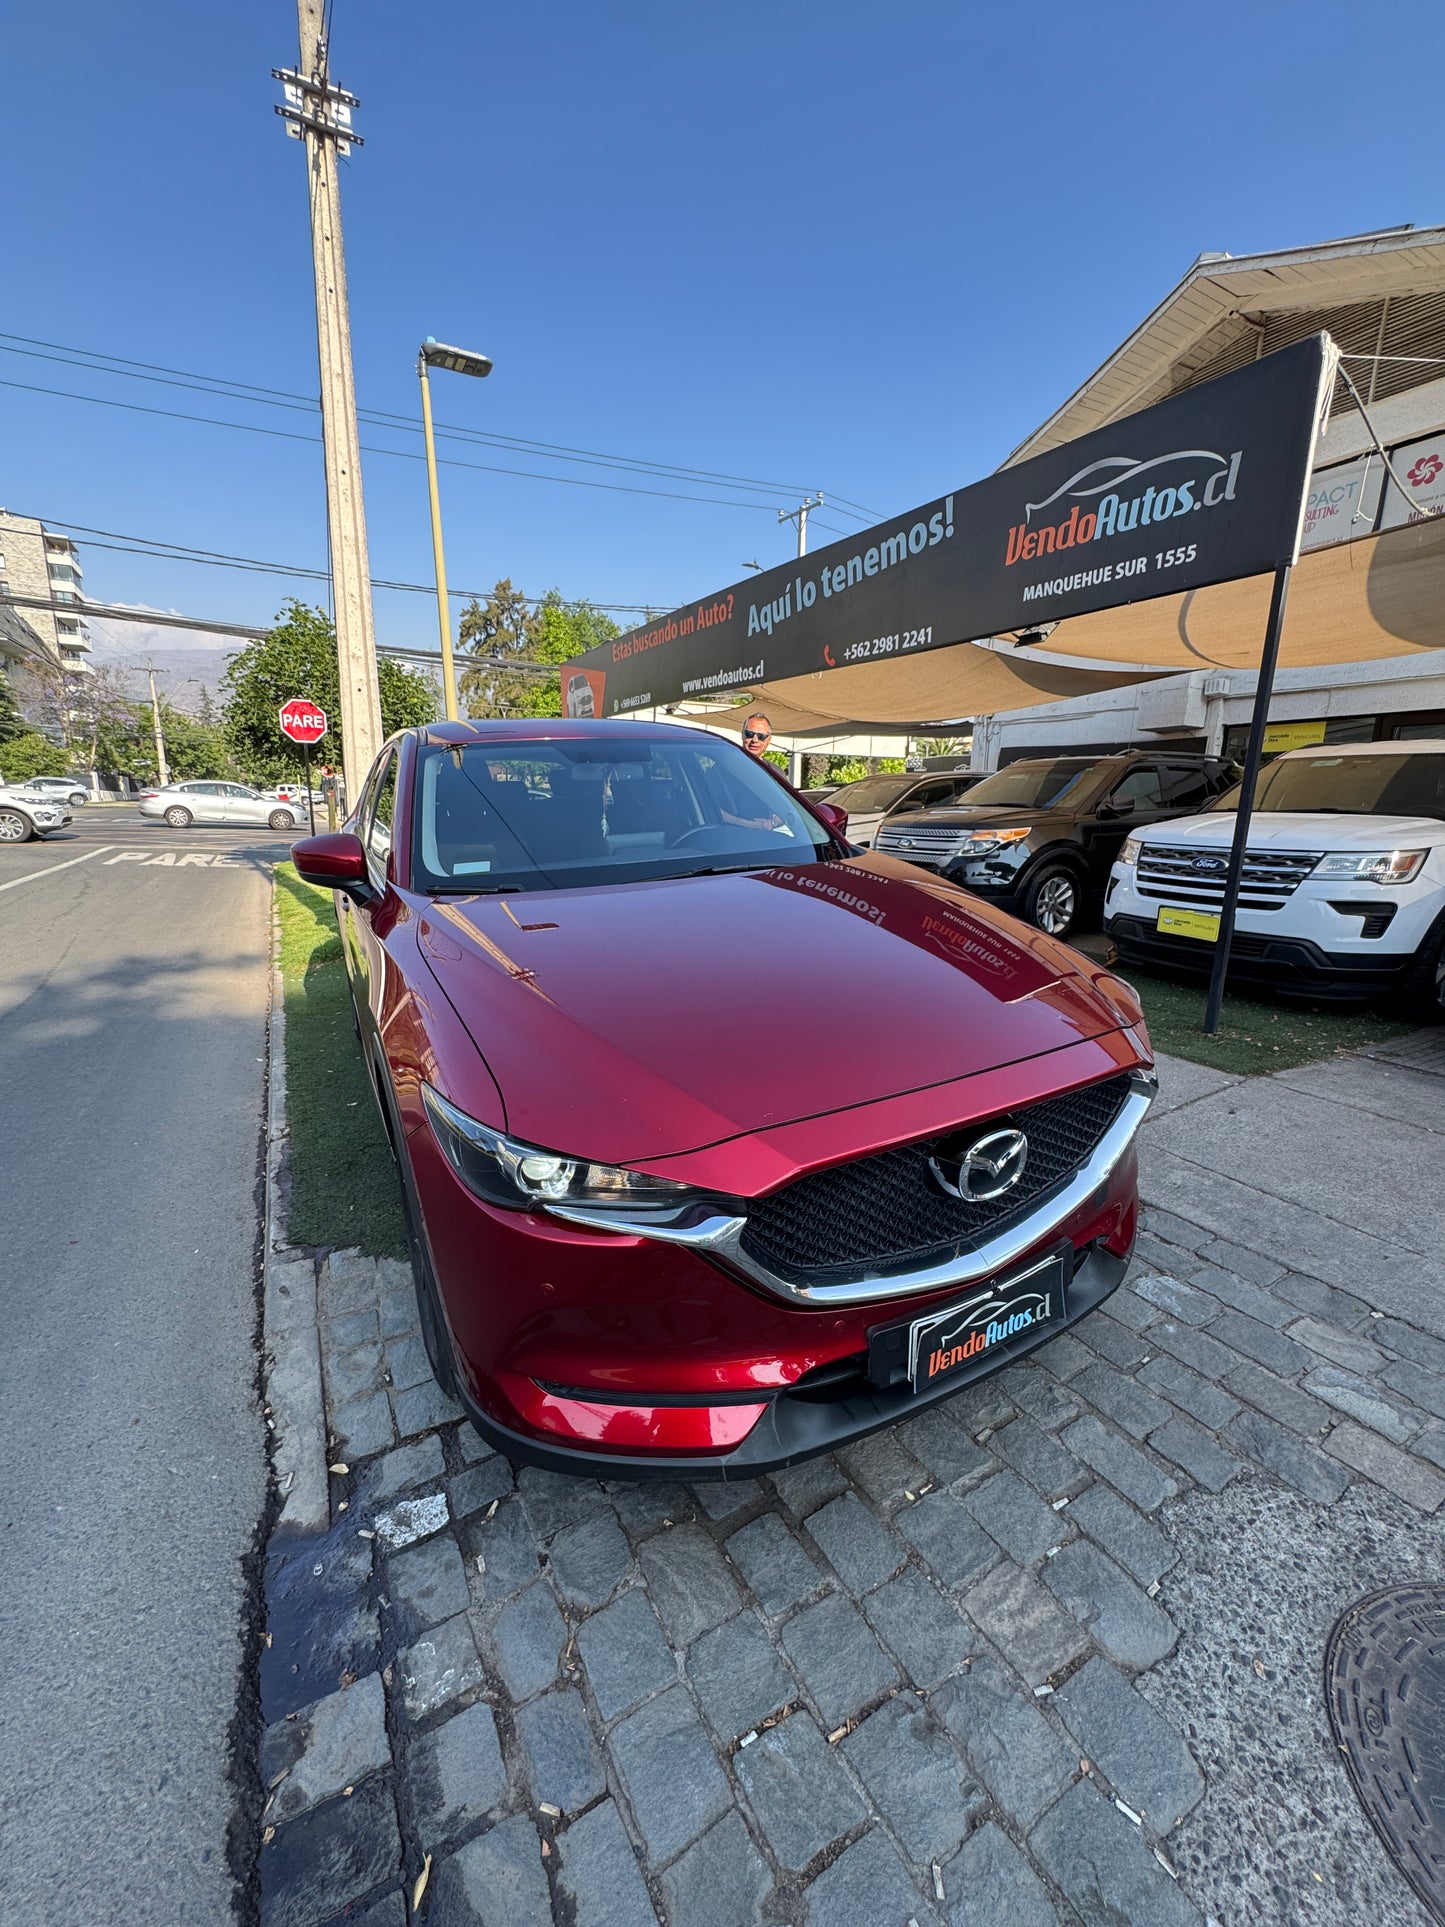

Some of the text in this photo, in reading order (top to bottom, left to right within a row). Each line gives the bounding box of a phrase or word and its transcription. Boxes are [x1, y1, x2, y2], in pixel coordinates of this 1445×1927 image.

[1005, 451, 1242, 566] VendoAutos.cl
[747, 495, 954, 637] Aquí lo tenemos!
[1022, 544, 1197, 601] MANQUEHUE SUR 1555
[612, 594, 734, 662] Estas buscando un Auto?
[843, 626, 932, 660] +562 2981 2241
[682, 659, 764, 693] www.vendoautos.cl
[283, 713, 324, 729] PARE
[102, 852, 256, 868] PARE
[1196, 859, 1219, 869] Ford
[929, 1293, 1051, 1378] VendoAutos.cl
